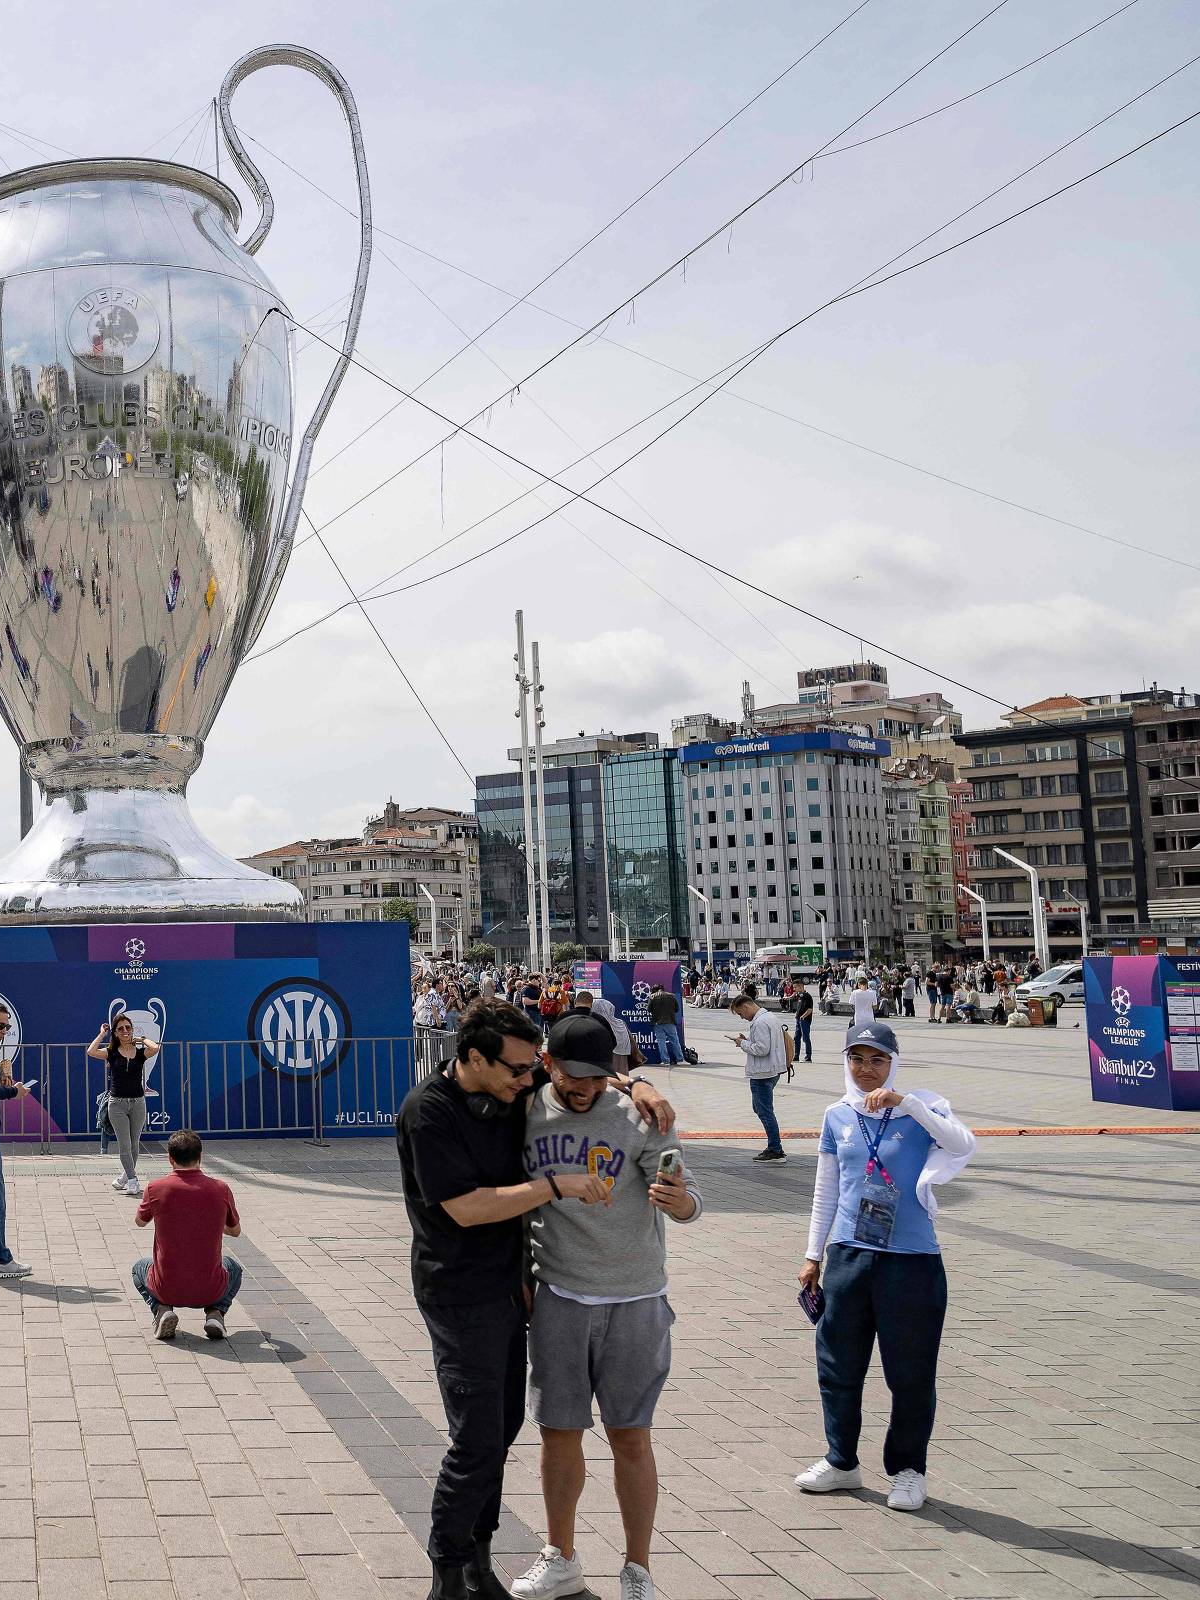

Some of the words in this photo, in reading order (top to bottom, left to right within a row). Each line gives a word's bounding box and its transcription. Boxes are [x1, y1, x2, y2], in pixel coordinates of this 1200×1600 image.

[79, 290, 138, 312] UEFA
[57, 400, 162, 433] CLUBS
[1102, 1026, 1146, 1038] CHAMPIONS
[1110, 1037, 1139, 1046] LEAGUE
[1116, 1076, 1140, 1086] FINAL
[335, 1111, 399, 1124] #UCLfin
